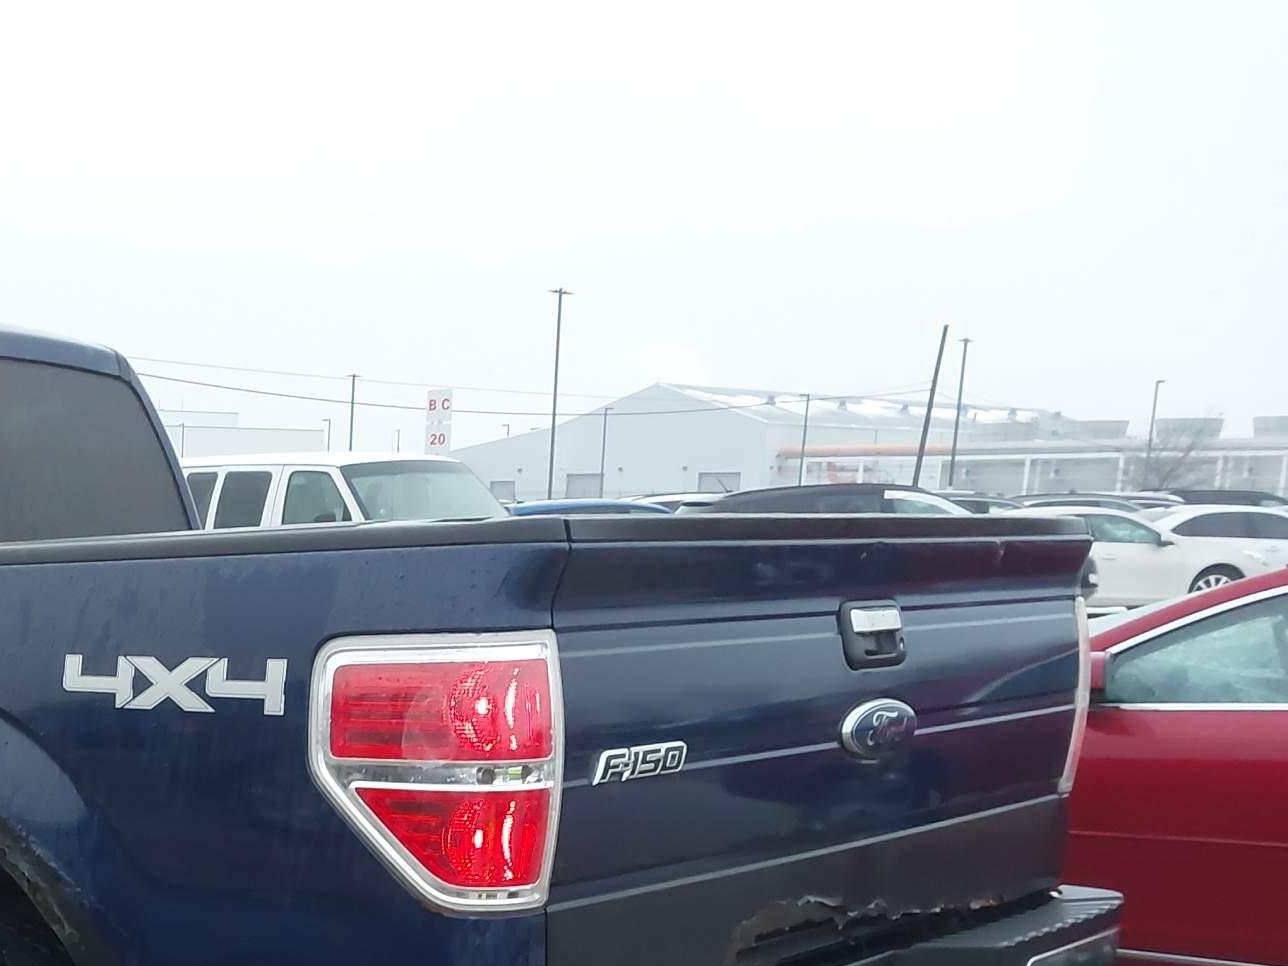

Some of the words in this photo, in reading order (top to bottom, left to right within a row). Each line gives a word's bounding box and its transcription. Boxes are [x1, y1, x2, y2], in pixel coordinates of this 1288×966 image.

[429, 399, 437, 411] B
[441, 398, 450, 410] C
[430, 433, 446, 445] 20
[593, 741, 687, 786] F-150
